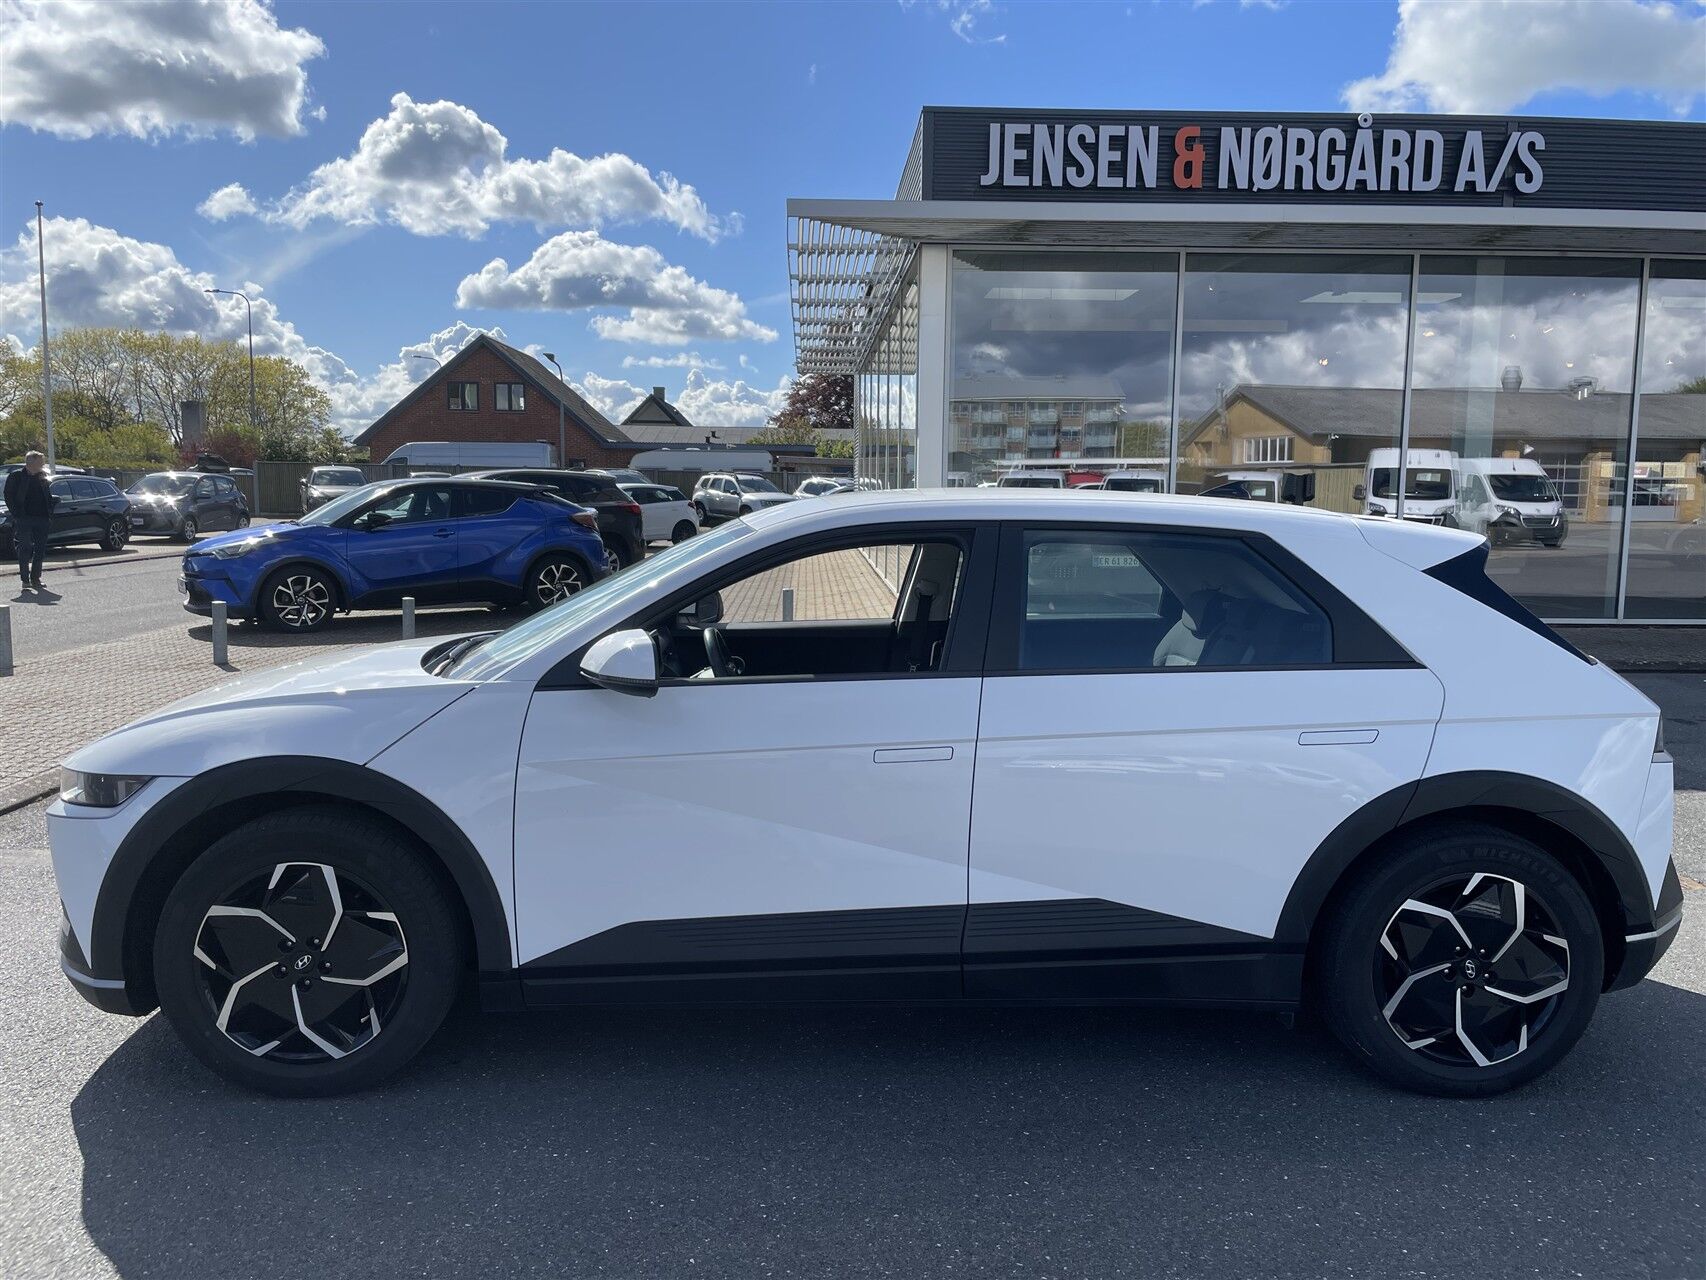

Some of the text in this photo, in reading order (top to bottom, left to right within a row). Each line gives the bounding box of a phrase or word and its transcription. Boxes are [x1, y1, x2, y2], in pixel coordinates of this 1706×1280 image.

[980, 112, 1546, 194] JENSEN & NØRGÅRD A/S
[1111, 557, 1120, 566] 61
